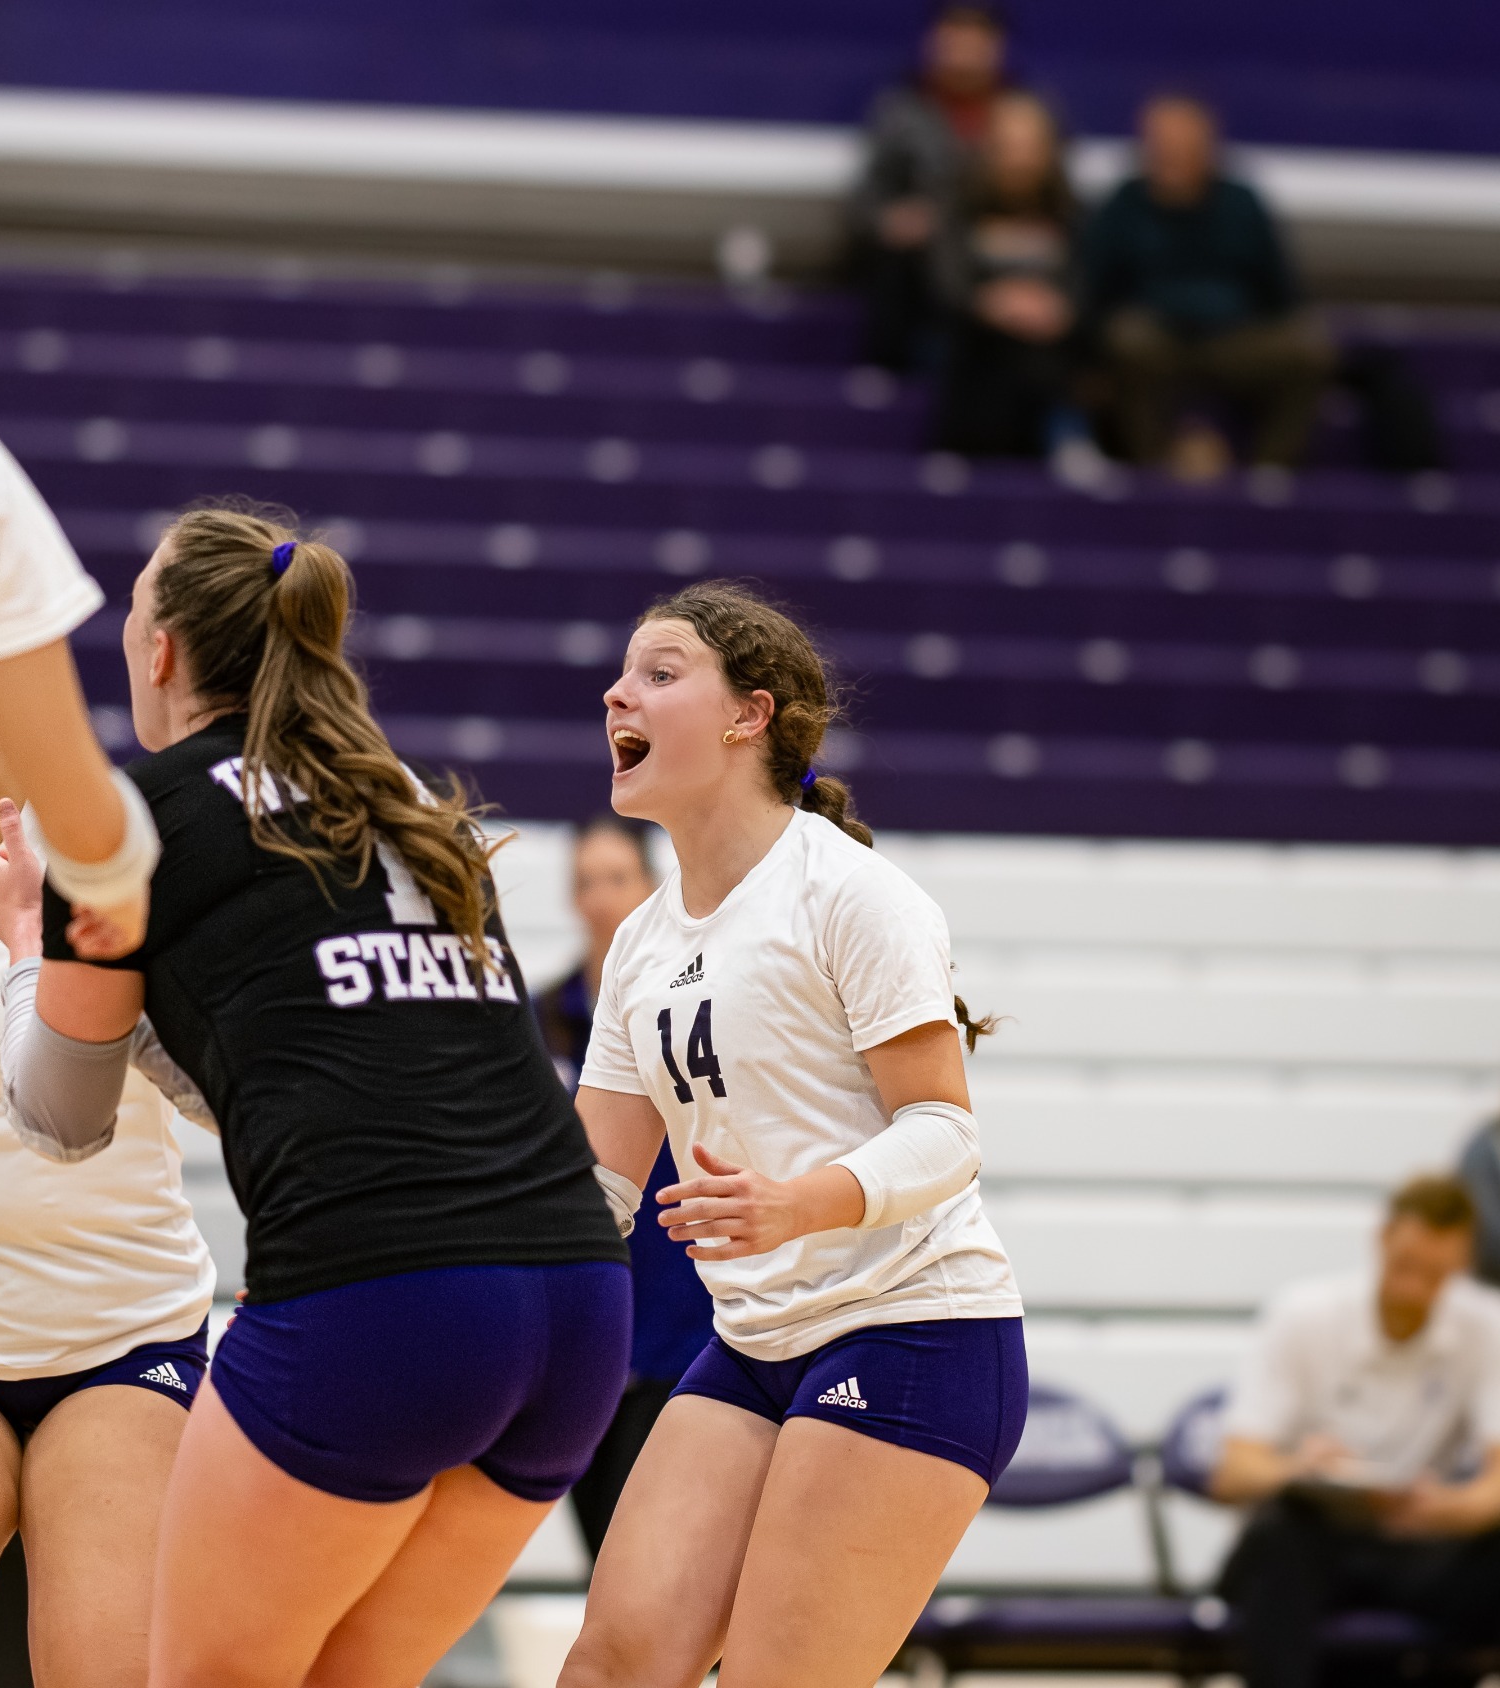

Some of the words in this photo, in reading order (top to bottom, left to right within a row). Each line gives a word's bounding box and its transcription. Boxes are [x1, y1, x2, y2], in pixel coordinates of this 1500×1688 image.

[669, 971, 705, 989] adidas
[657, 998, 728, 1105] 14
[817, 1393, 868, 1410] adidas
